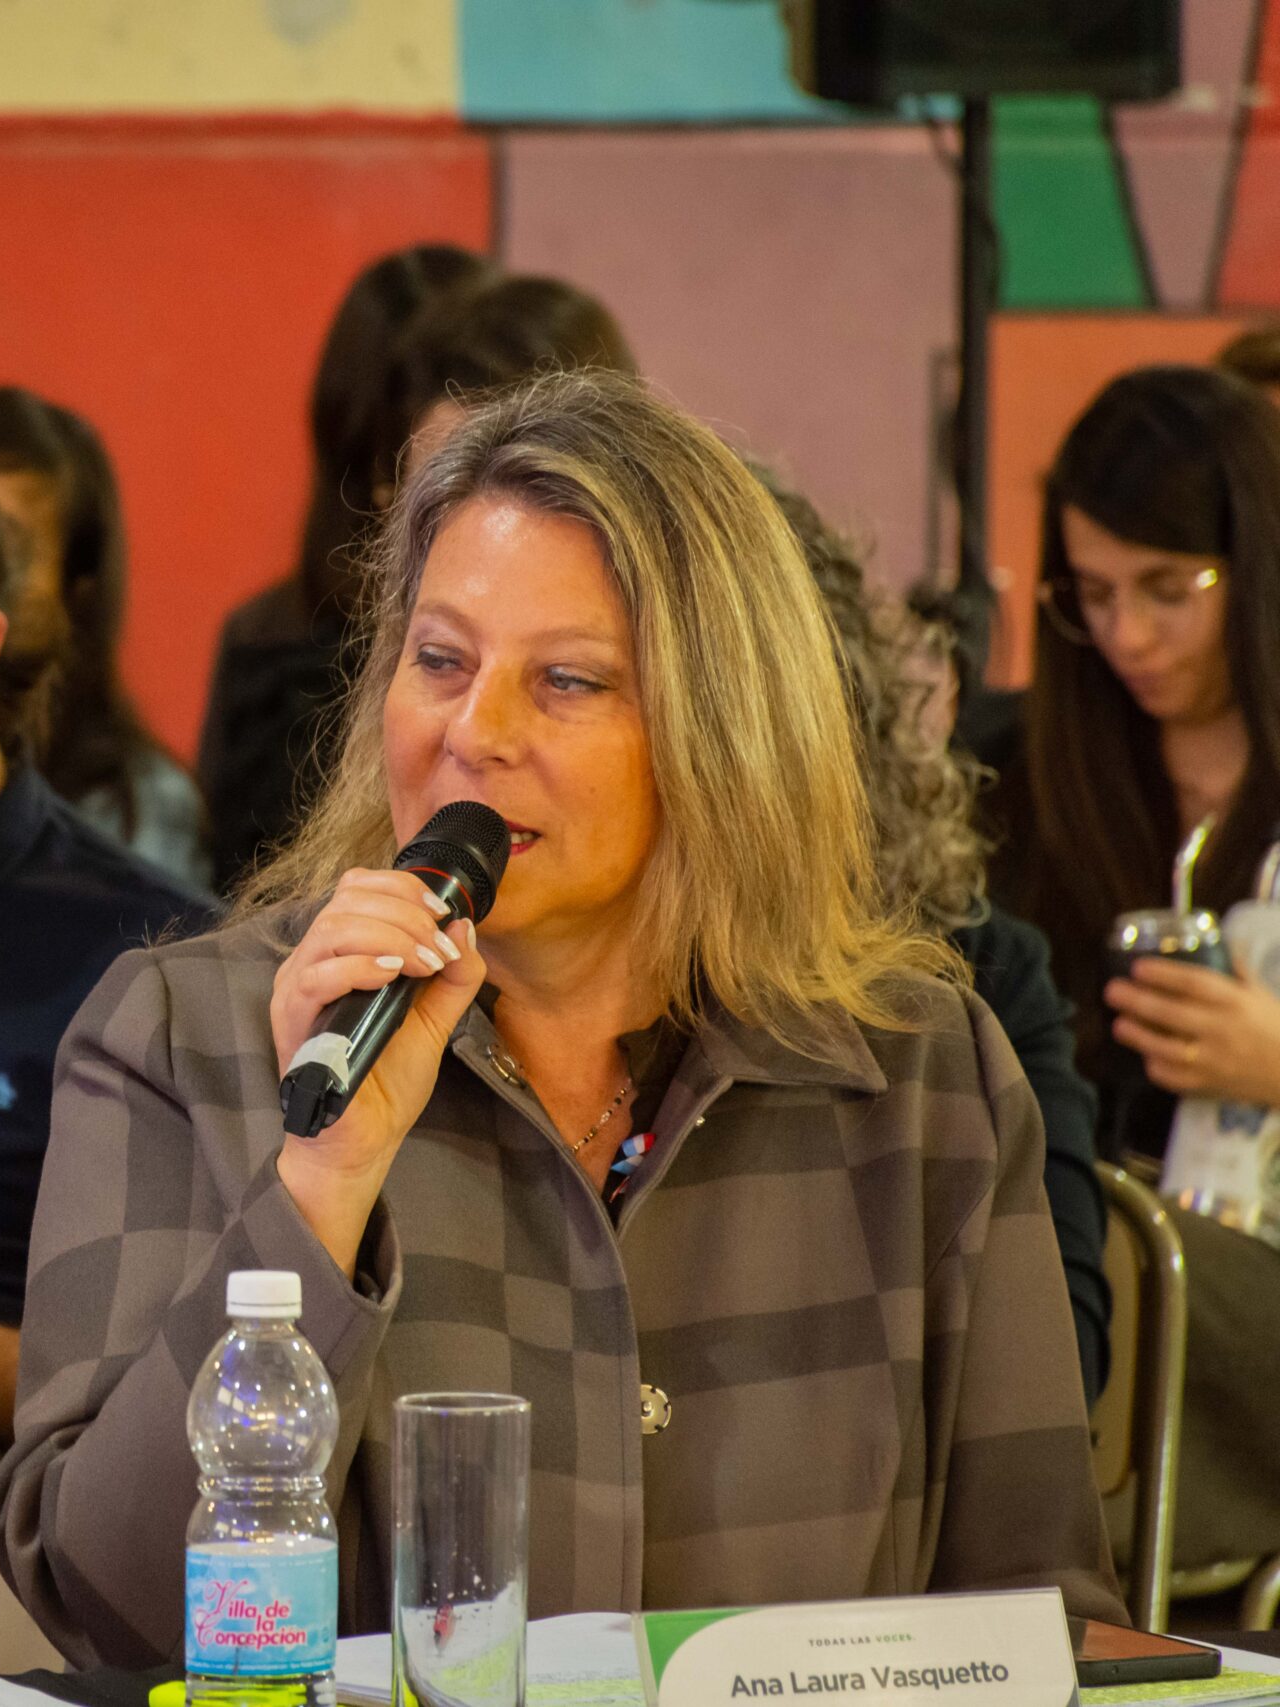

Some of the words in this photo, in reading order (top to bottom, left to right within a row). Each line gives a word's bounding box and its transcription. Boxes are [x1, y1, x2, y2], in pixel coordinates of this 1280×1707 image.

[204, 1580, 257, 1618] Villa
[265, 1600, 290, 1618] de
[256, 1614, 274, 1632] la
[808, 1637, 846, 1647] TODAS
[850, 1636, 871, 1645] LAS
[731, 1675, 784, 1697] Ana
[790, 1671, 866, 1694] Laura
[871, 1661, 1009, 1690] Vasquetto
